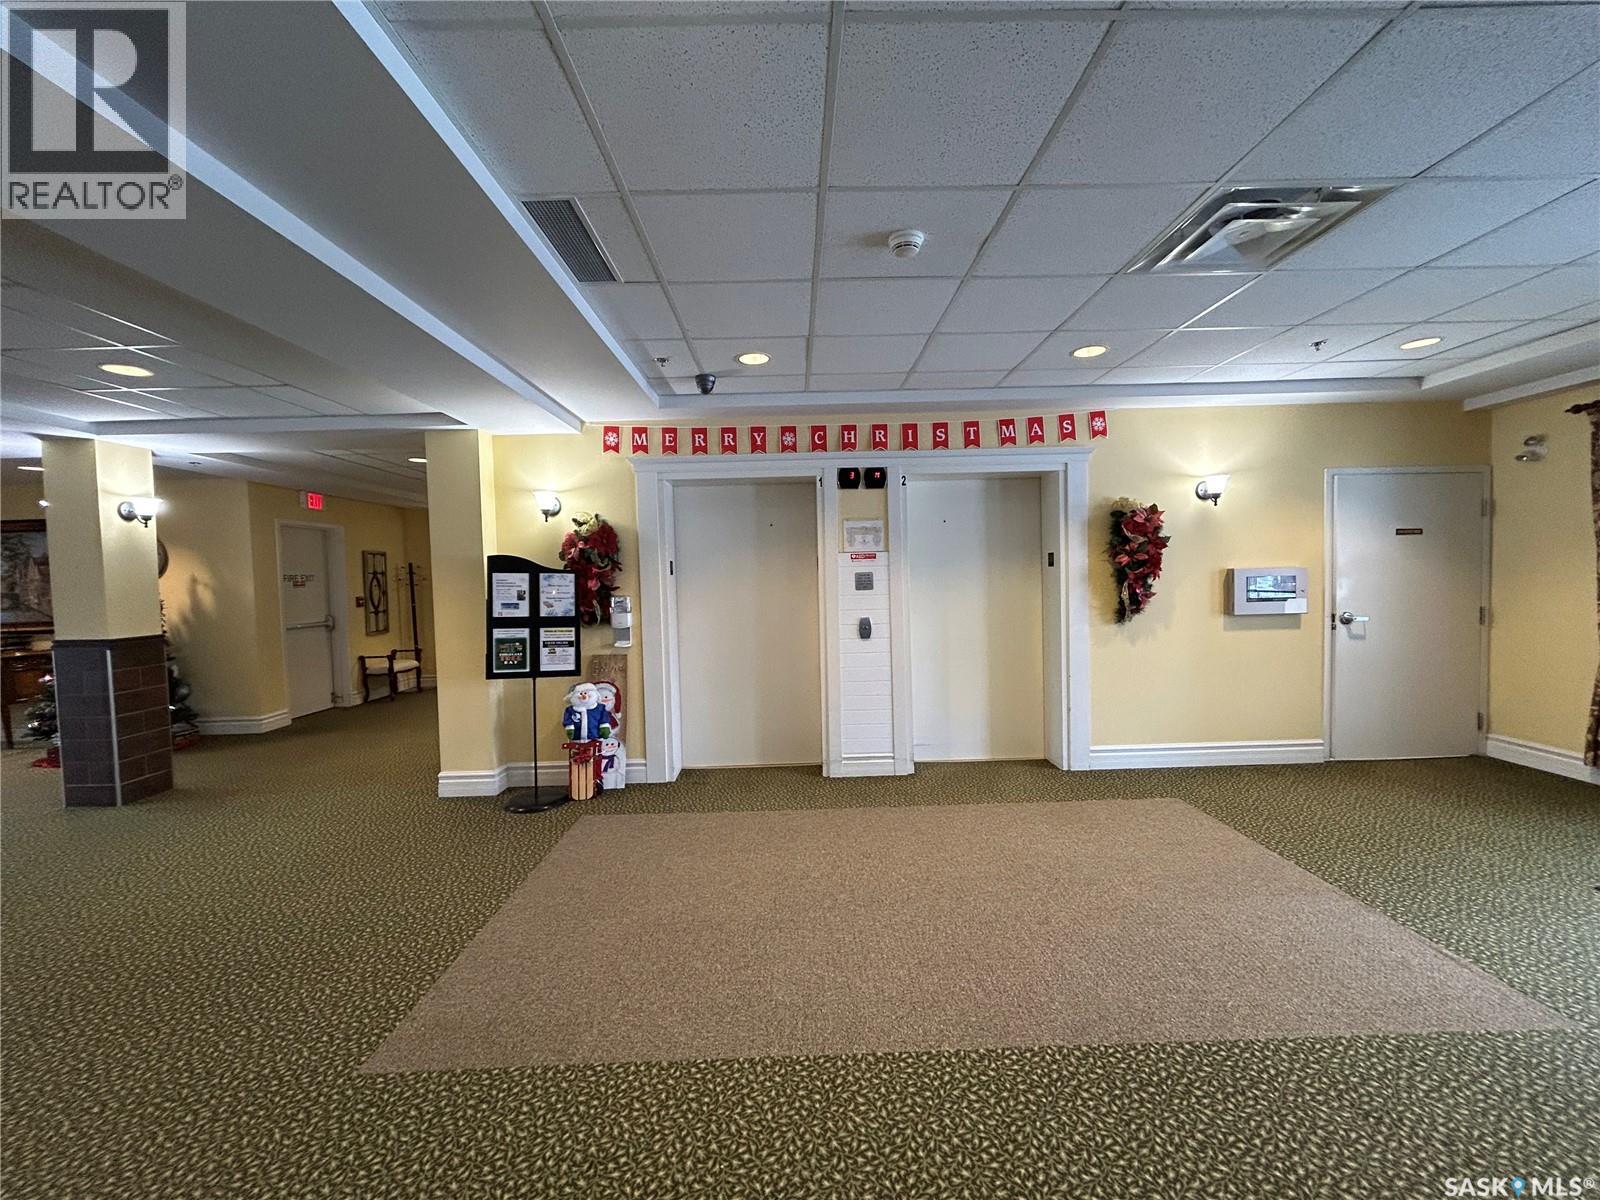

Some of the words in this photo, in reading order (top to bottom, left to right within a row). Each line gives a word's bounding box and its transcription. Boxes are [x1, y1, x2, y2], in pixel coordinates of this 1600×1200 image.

[633, 432, 764, 447] MERRY
[814, 420, 1073, 444] CHRISTMAS
[849, 471, 855, 479] 3
[901, 475, 907, 486] 2
[818, 477, 823, 487] 1
[307, 493, 322, 509] EXIT
